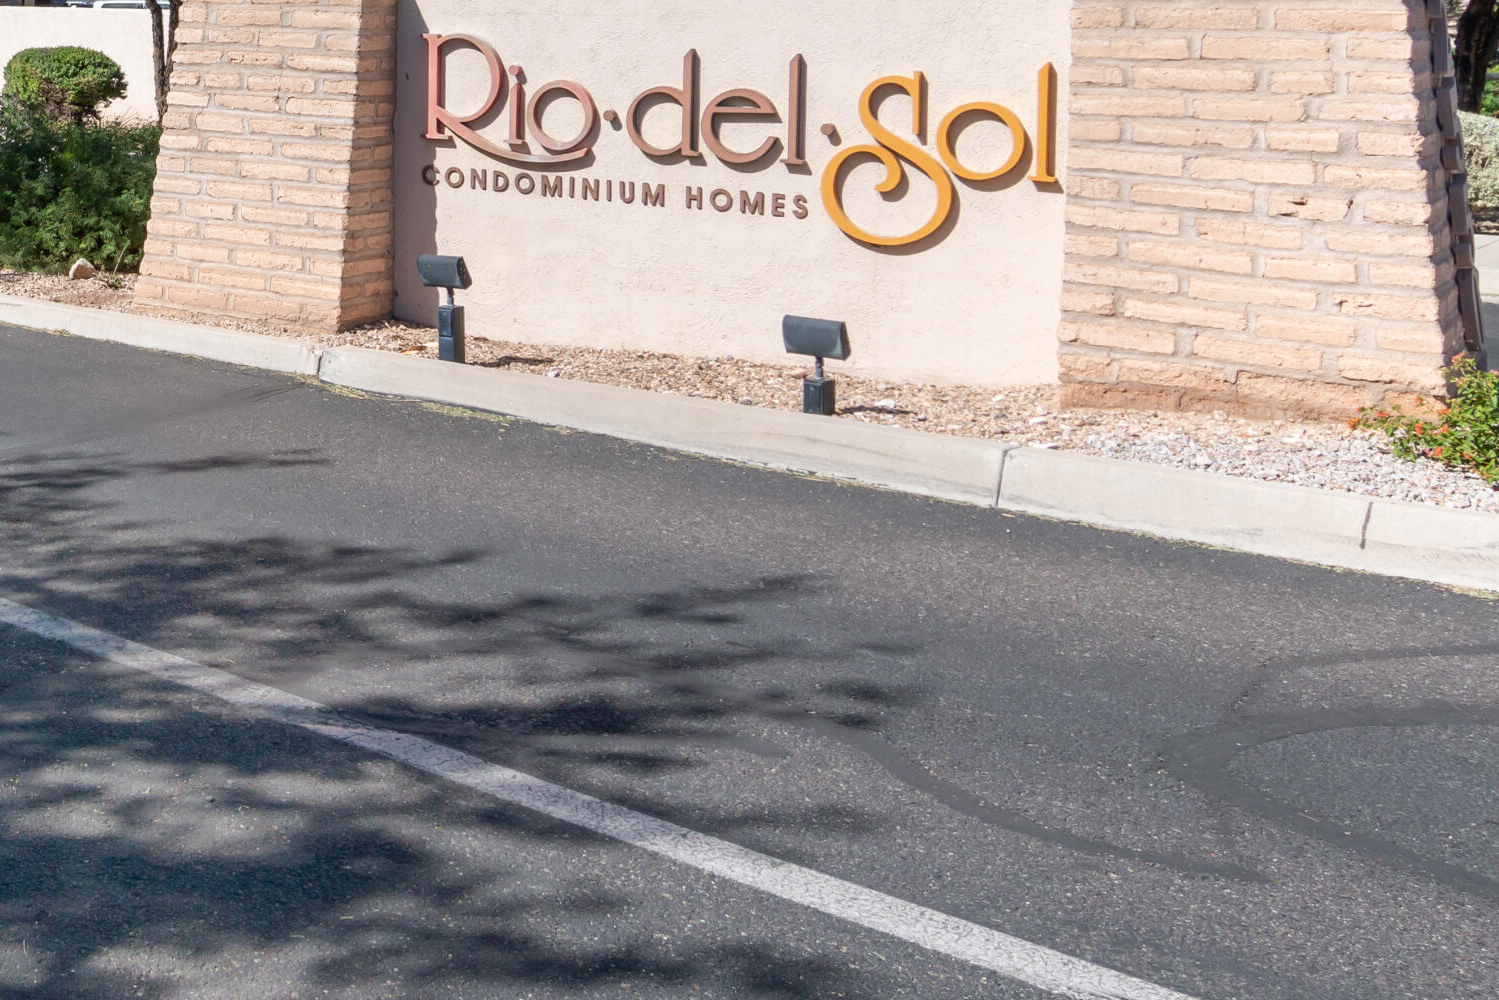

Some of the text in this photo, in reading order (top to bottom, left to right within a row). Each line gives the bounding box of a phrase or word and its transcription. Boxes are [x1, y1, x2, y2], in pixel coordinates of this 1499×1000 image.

[422, 165, 810, 219] CONDOMINIUM HOMES
[820, 62, 1059, 246] Sol
